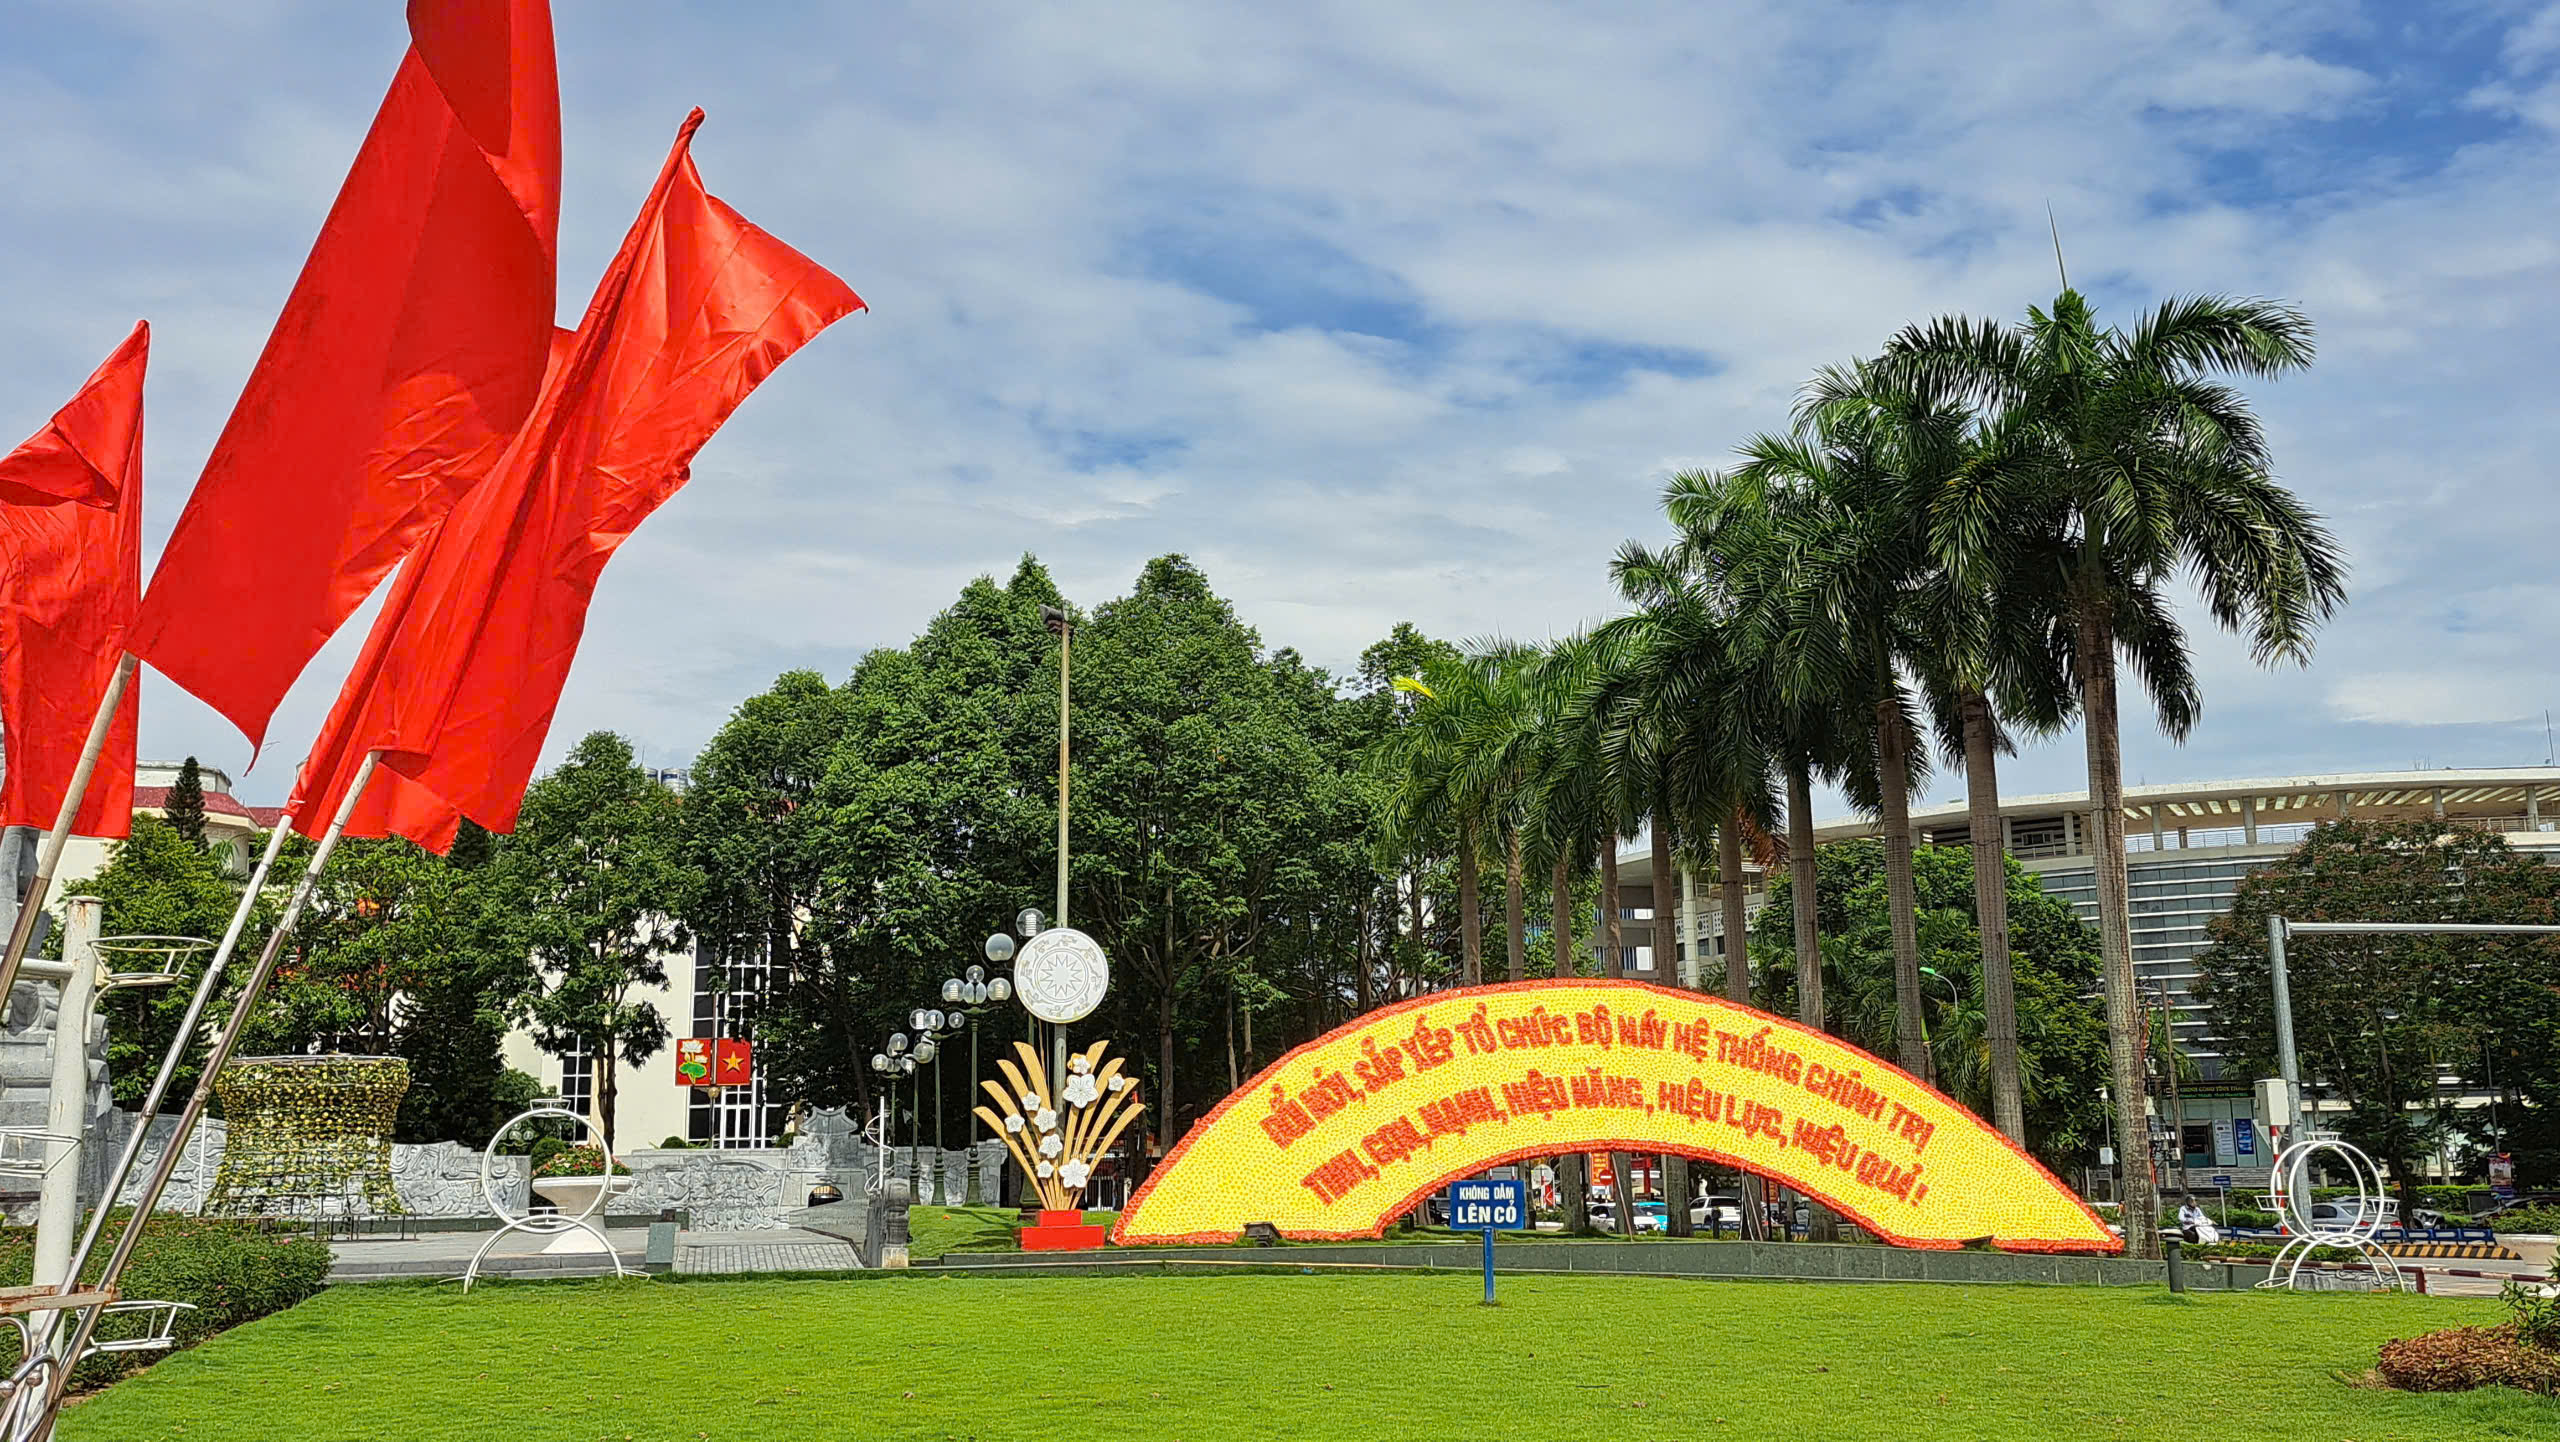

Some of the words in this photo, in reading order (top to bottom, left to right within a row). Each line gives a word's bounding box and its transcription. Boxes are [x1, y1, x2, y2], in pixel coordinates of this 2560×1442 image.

[1399, 1014, 1454, 1073] XẾP
[1455, 1002, 1497, 1055] TỔ
[1497, 1005, 1573, 1050] CHỨC
[1575, 1004, 1612, 1051] BỘ
[1618, 1009, 1667, 1049] MÁY
[1674, 1017, 1709, 1063] HỆ
[1715, 1026, 1803, 1085] THỐNG
[1888, 1102, 1936, 1154] TRỊ
[1502, 1069, 1569, 1121] HIỆU
[1658, 1077, 1723, 1125] HIỆU
[1792, 1118, 1859, 1171] HIỆU
[1457, 1202, 1491, 1224] LÊN
[1494, 1200, 1517, 1224] CỎ
[1459, 1184, 1490, 1200] KHÔNG
